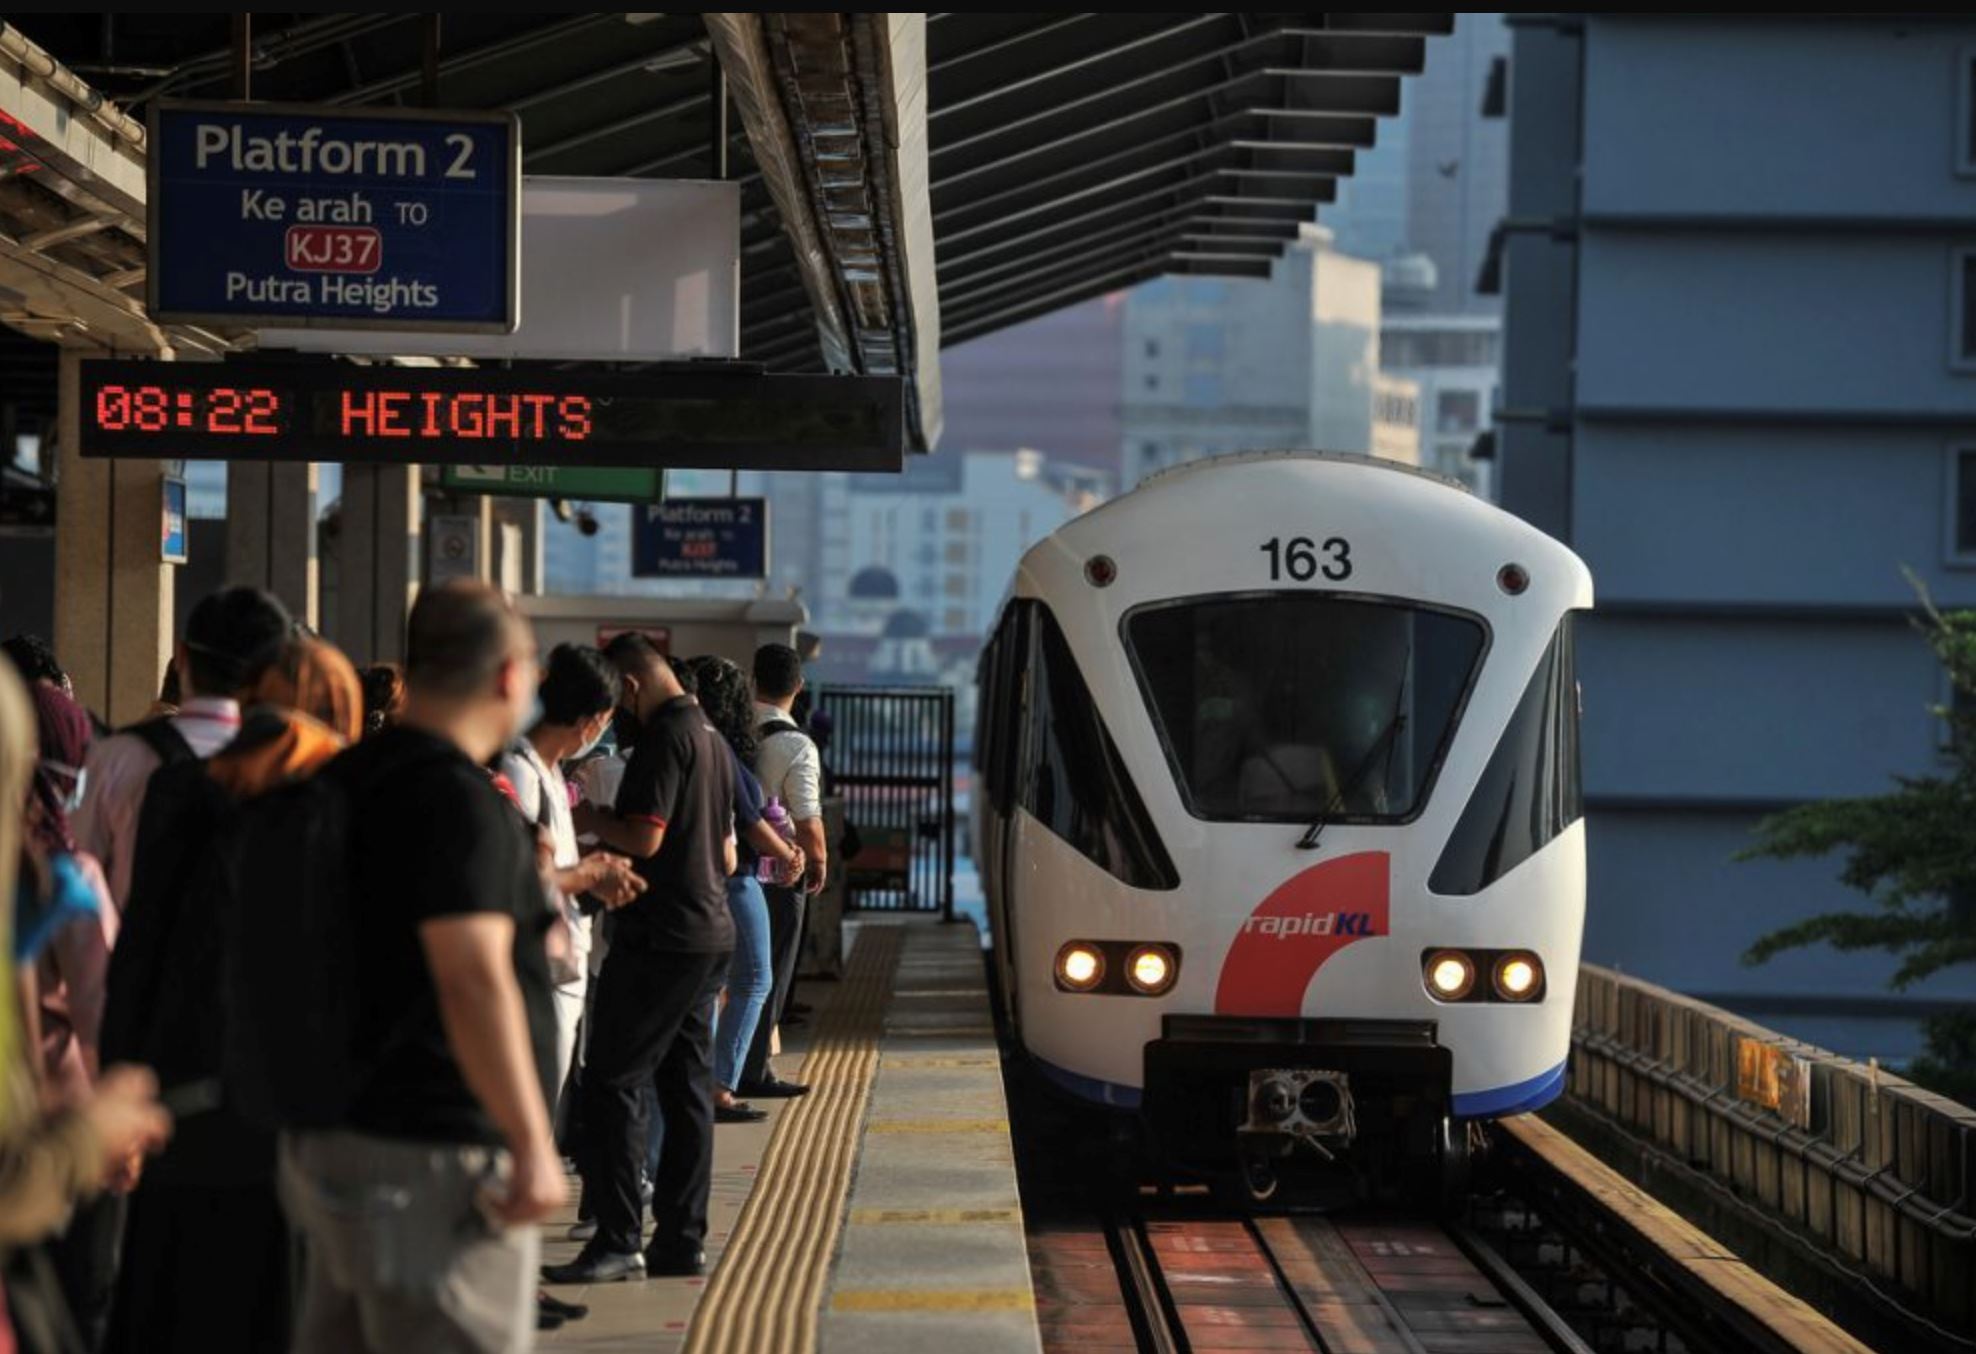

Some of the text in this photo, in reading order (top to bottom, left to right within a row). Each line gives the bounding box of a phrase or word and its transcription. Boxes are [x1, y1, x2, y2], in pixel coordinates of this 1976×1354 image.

[197, 125, 476, 178] Platform 2
[242, 189, 428, 225] Ke arah TO
[291, 233, 377, 264] KJ37
[227, 272, 439, 312] Putra Heights
[97, 385, 278, 434] 08:22
[341, 391, 591, 440] HEIGHTS
[510, 465, 559, 484] EXIT
[647, 504, 753, 524] Platform 2
[1260, 536, 1353, 582] 163
[1245, 912, 1375, 940] rapidKL
